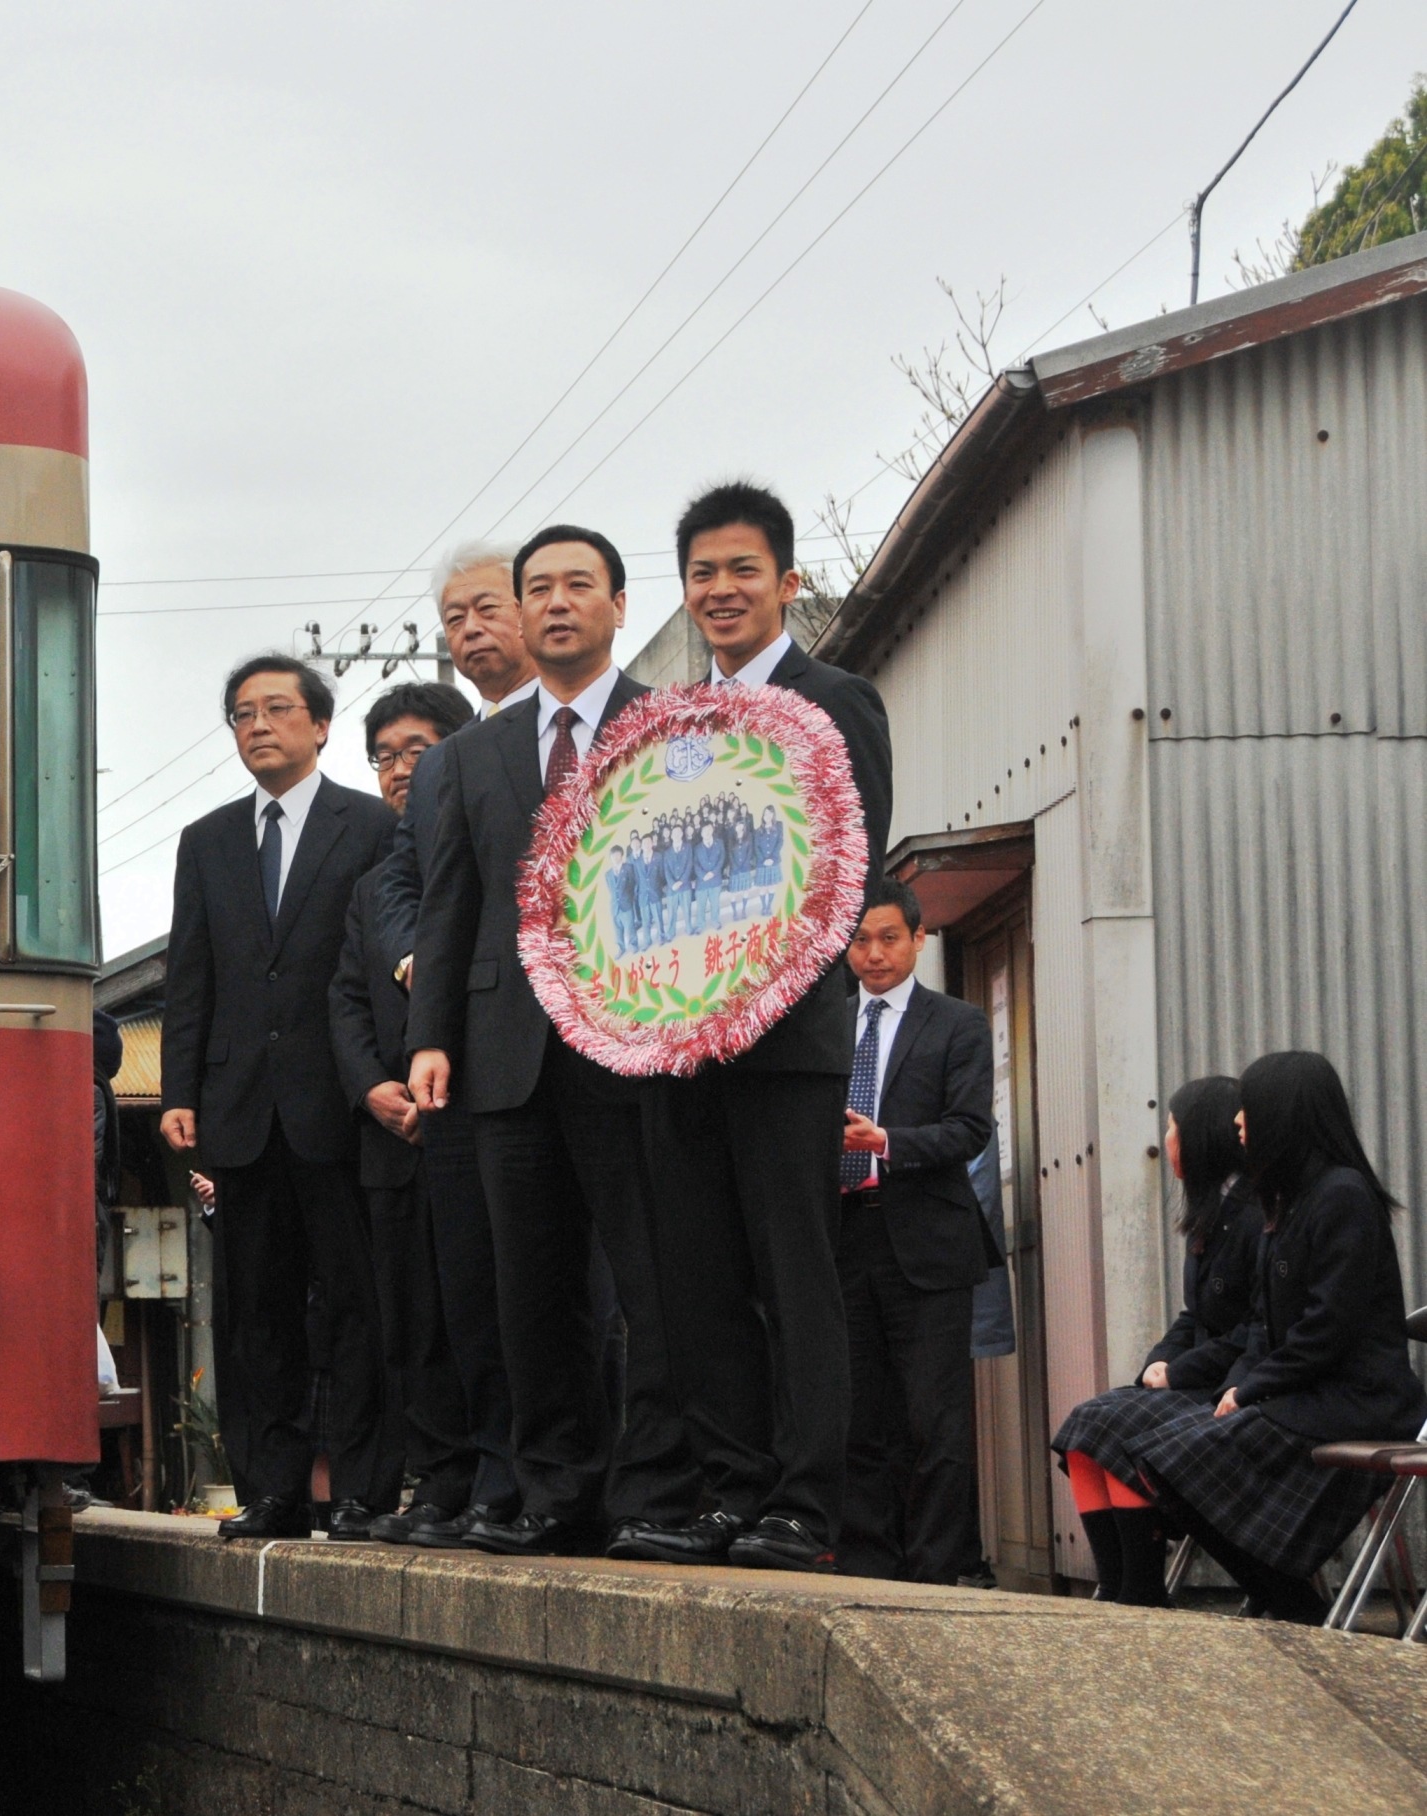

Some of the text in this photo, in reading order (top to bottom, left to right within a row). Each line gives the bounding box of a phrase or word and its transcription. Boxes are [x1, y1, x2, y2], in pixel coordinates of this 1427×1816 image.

[590, 948, 679, 1002] ありがとう
